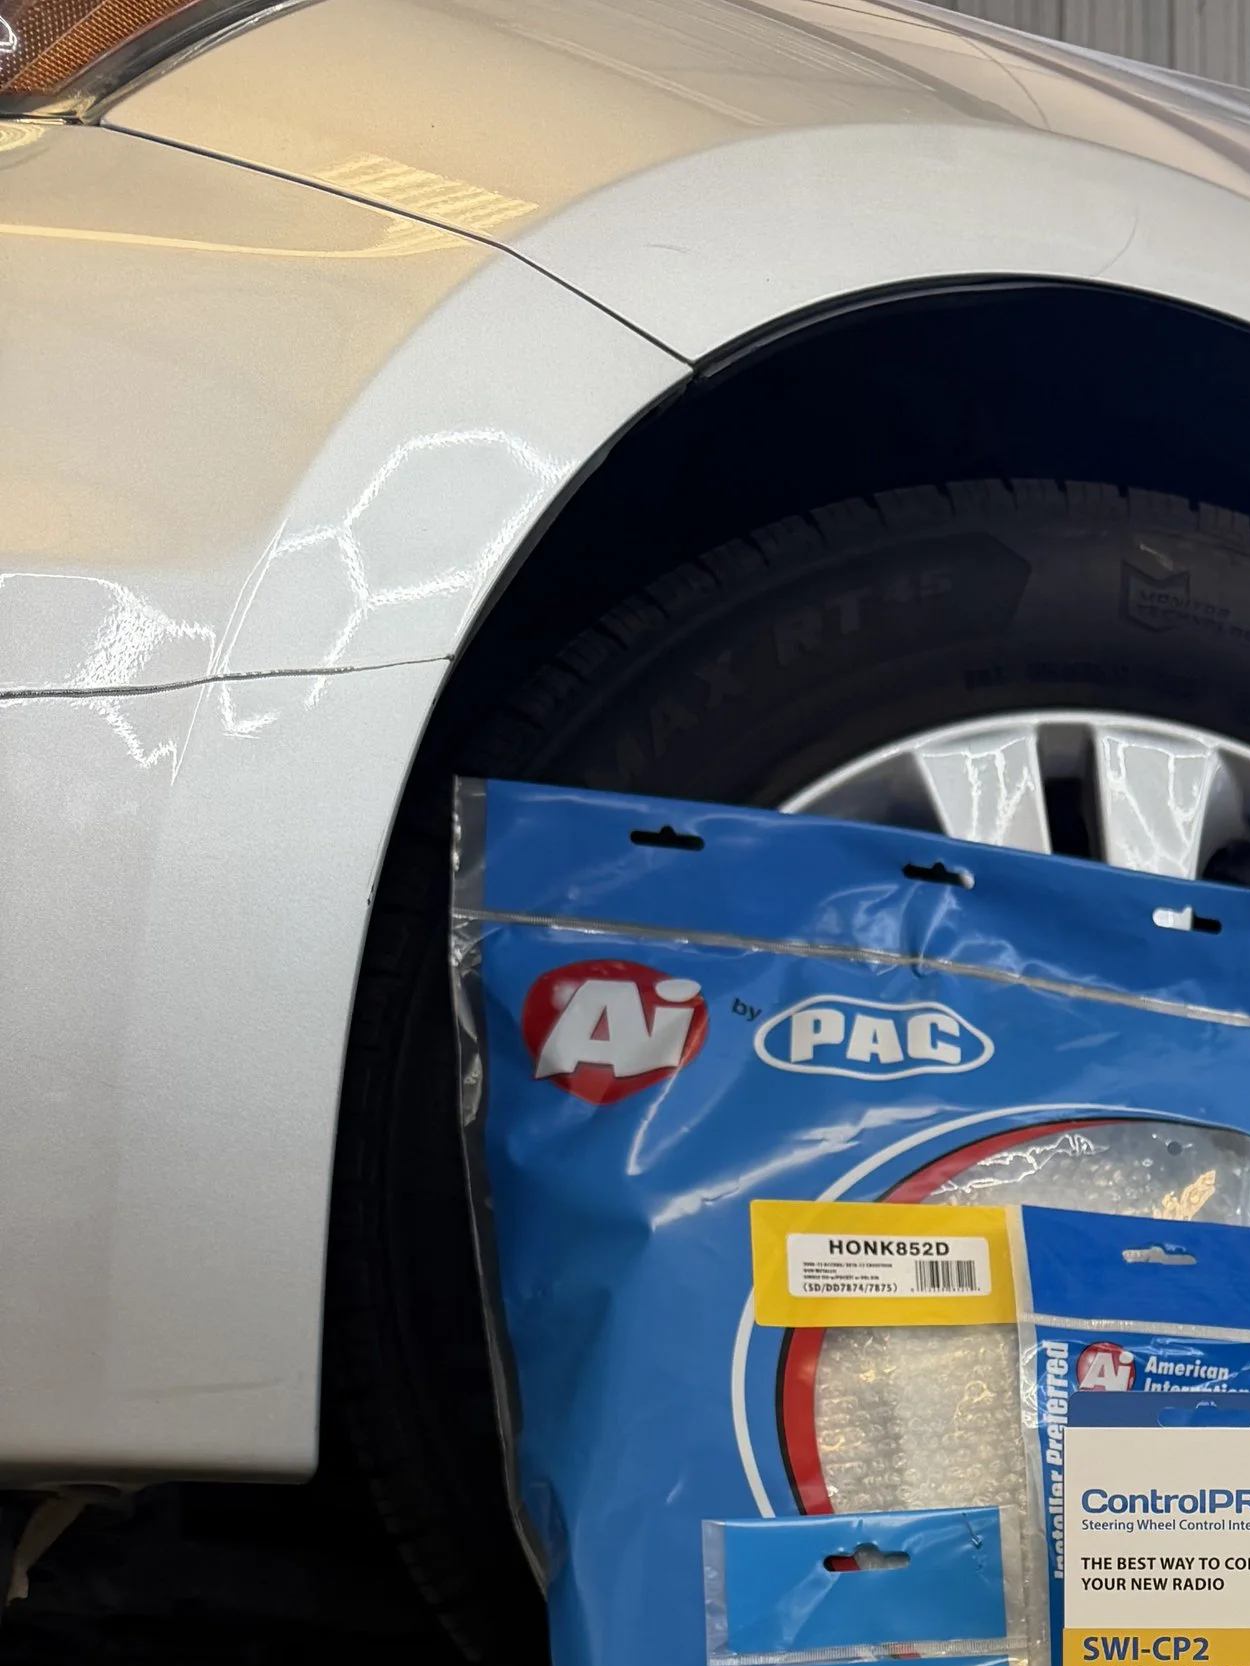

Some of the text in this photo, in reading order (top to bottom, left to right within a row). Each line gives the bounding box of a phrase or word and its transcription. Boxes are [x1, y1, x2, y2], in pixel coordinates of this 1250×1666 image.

[535, 979, 962, 1079] Ai by PAC
[829, 1239, 950, 1257] HONK852D
[1079, 1351, 1135, 1392] Ai
[1144, 1355, 1229, 1380] American
[1082, 1520, 1134, 1532] Steering
[1137, 1520, 1176, 1530] Wheel
[1179, 1520, 1224, 1530] Control
[1081, 1557, 1112, 1570] THE
[1117, 1557, 1156, 1570] BEST
[1160, 1557, 1196, 1570] WAY
[1199, 1557, 1221, 1570] TO
[1081, 1578, 1225, 1591] YOUR NEW RADIO
[1083, 1636, 1210, 1661] SWI-CP2
